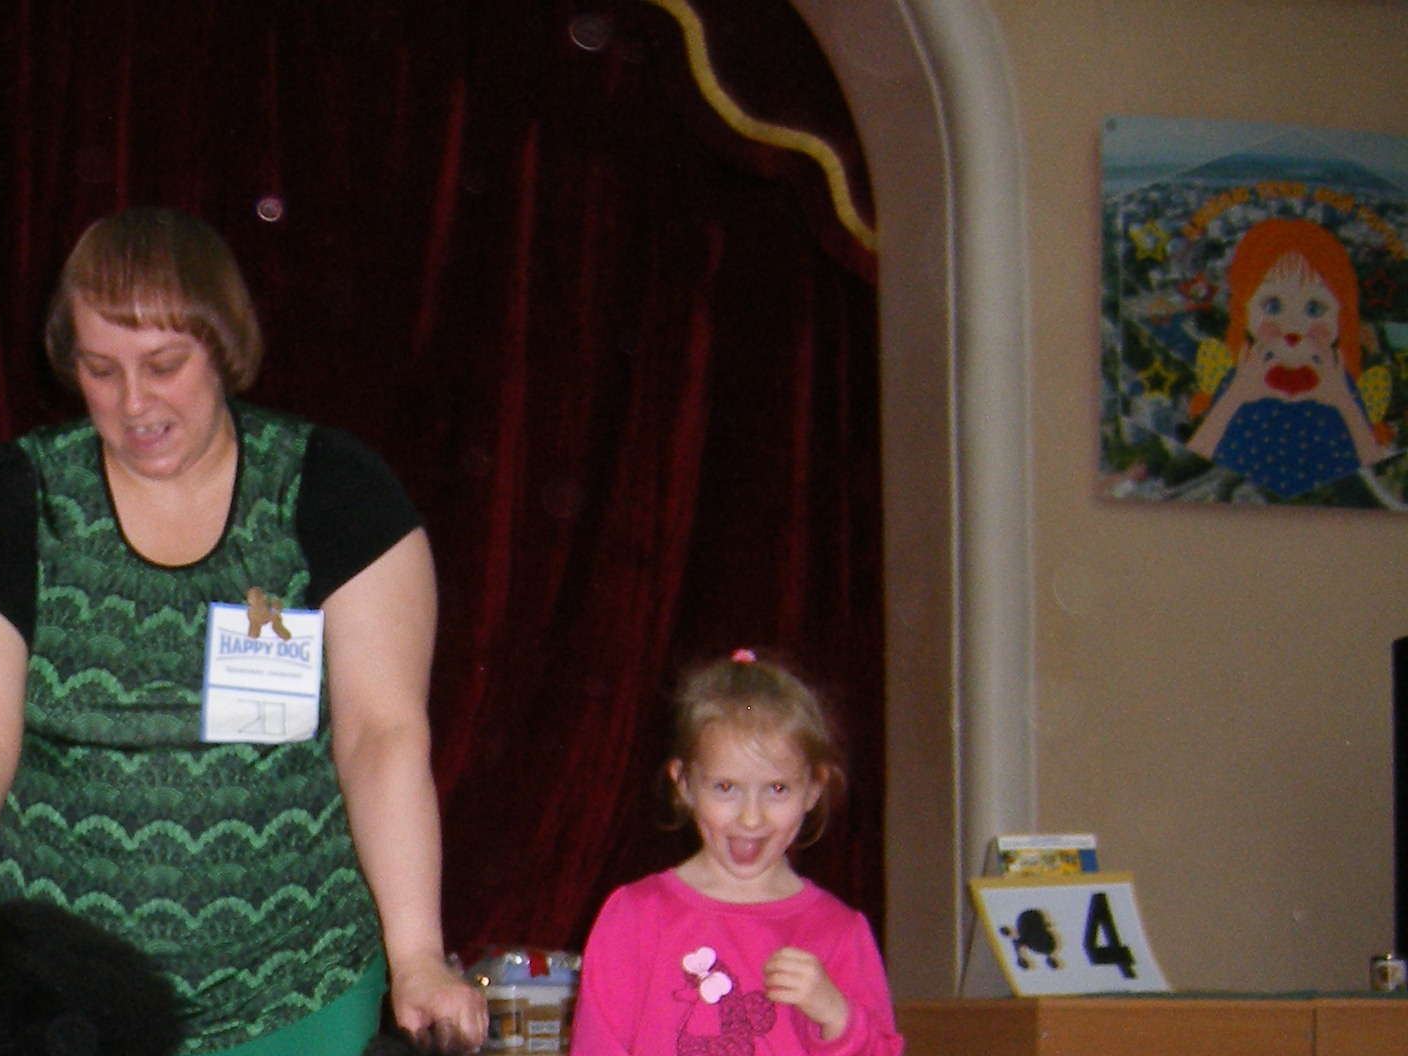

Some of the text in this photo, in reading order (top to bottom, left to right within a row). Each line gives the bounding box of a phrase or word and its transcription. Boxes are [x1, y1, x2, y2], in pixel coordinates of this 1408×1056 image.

[218, 632, 311, 663] HAPPY DOG
[1083, 892, 1137, 980] 4
